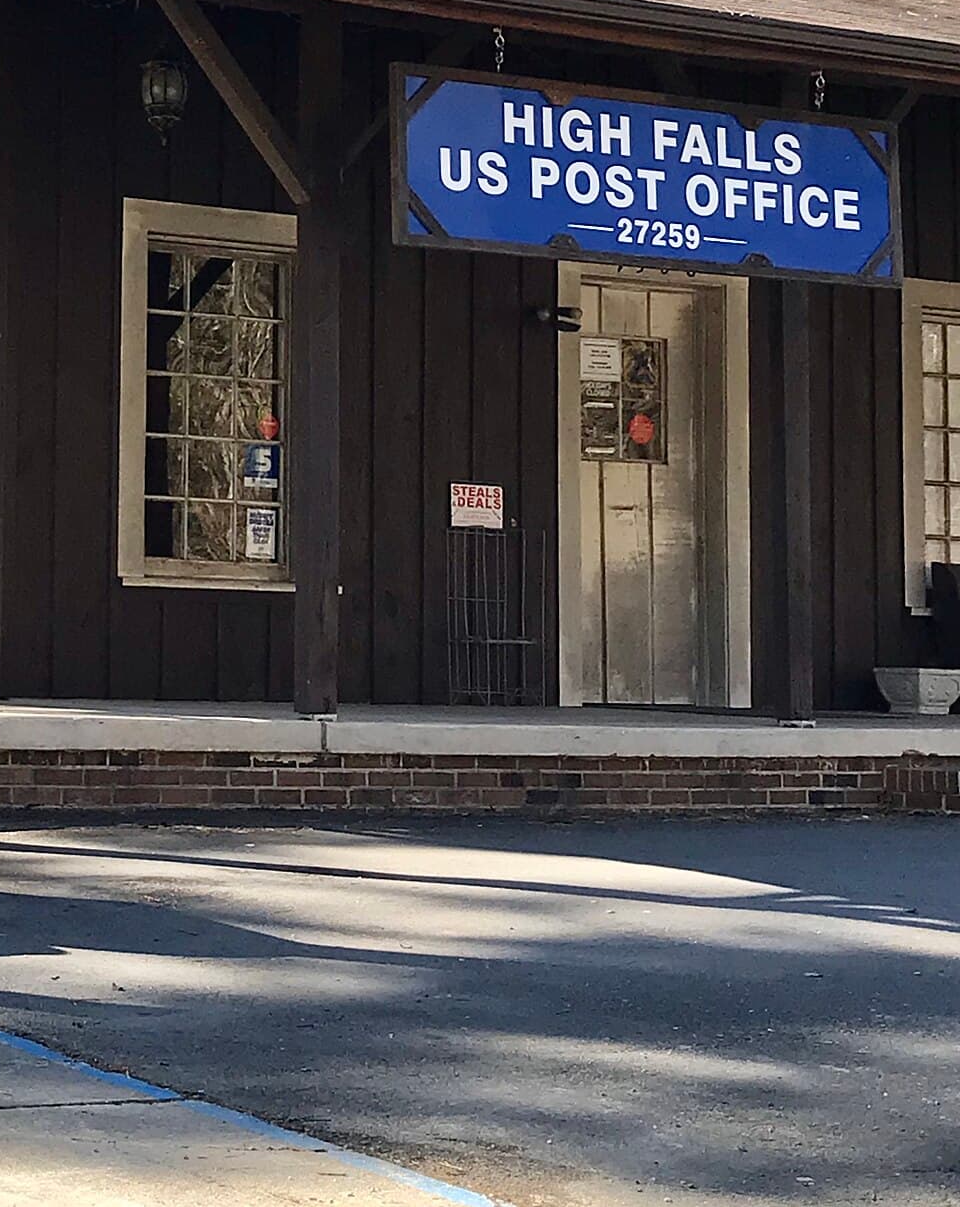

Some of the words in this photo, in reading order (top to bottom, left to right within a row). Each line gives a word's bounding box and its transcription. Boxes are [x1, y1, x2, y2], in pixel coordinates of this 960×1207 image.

[503, 102, 631, 157] HIGH
[653, 119, 802, 175] FALLS
[440, 147, 509, 196] US
[531, 157, 666, 211] POST
[685, 174, 861, 231] OFFICE
[617, 217, 701, 250] 27259
[452, 485, 501, 498] STEALS
[457, 497, 502, 510] DEALS
